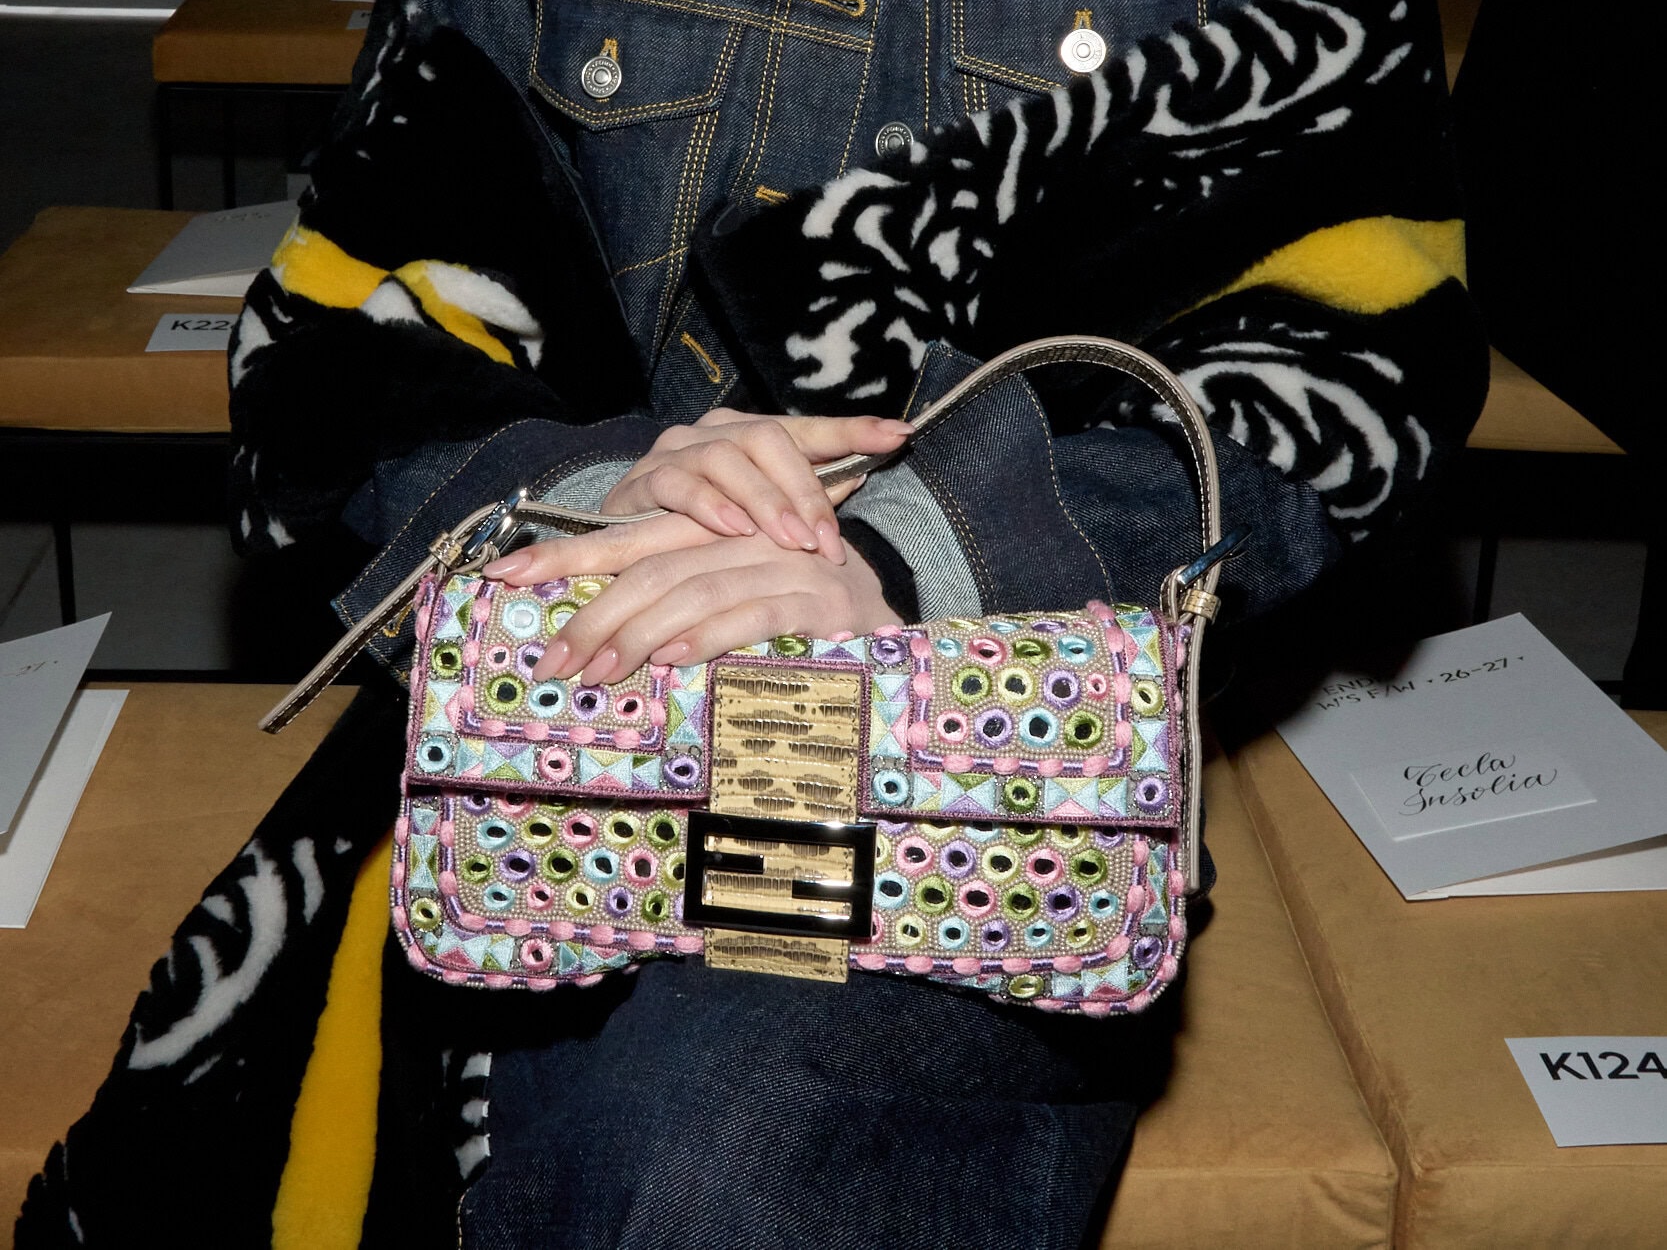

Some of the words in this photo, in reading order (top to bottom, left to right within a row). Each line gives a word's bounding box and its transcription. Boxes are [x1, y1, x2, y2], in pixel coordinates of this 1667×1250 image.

[171, 320, 236, 330] K22
[1323, 678, 1374, 696] END
[1539, 1051, 1667, 1081] K124
